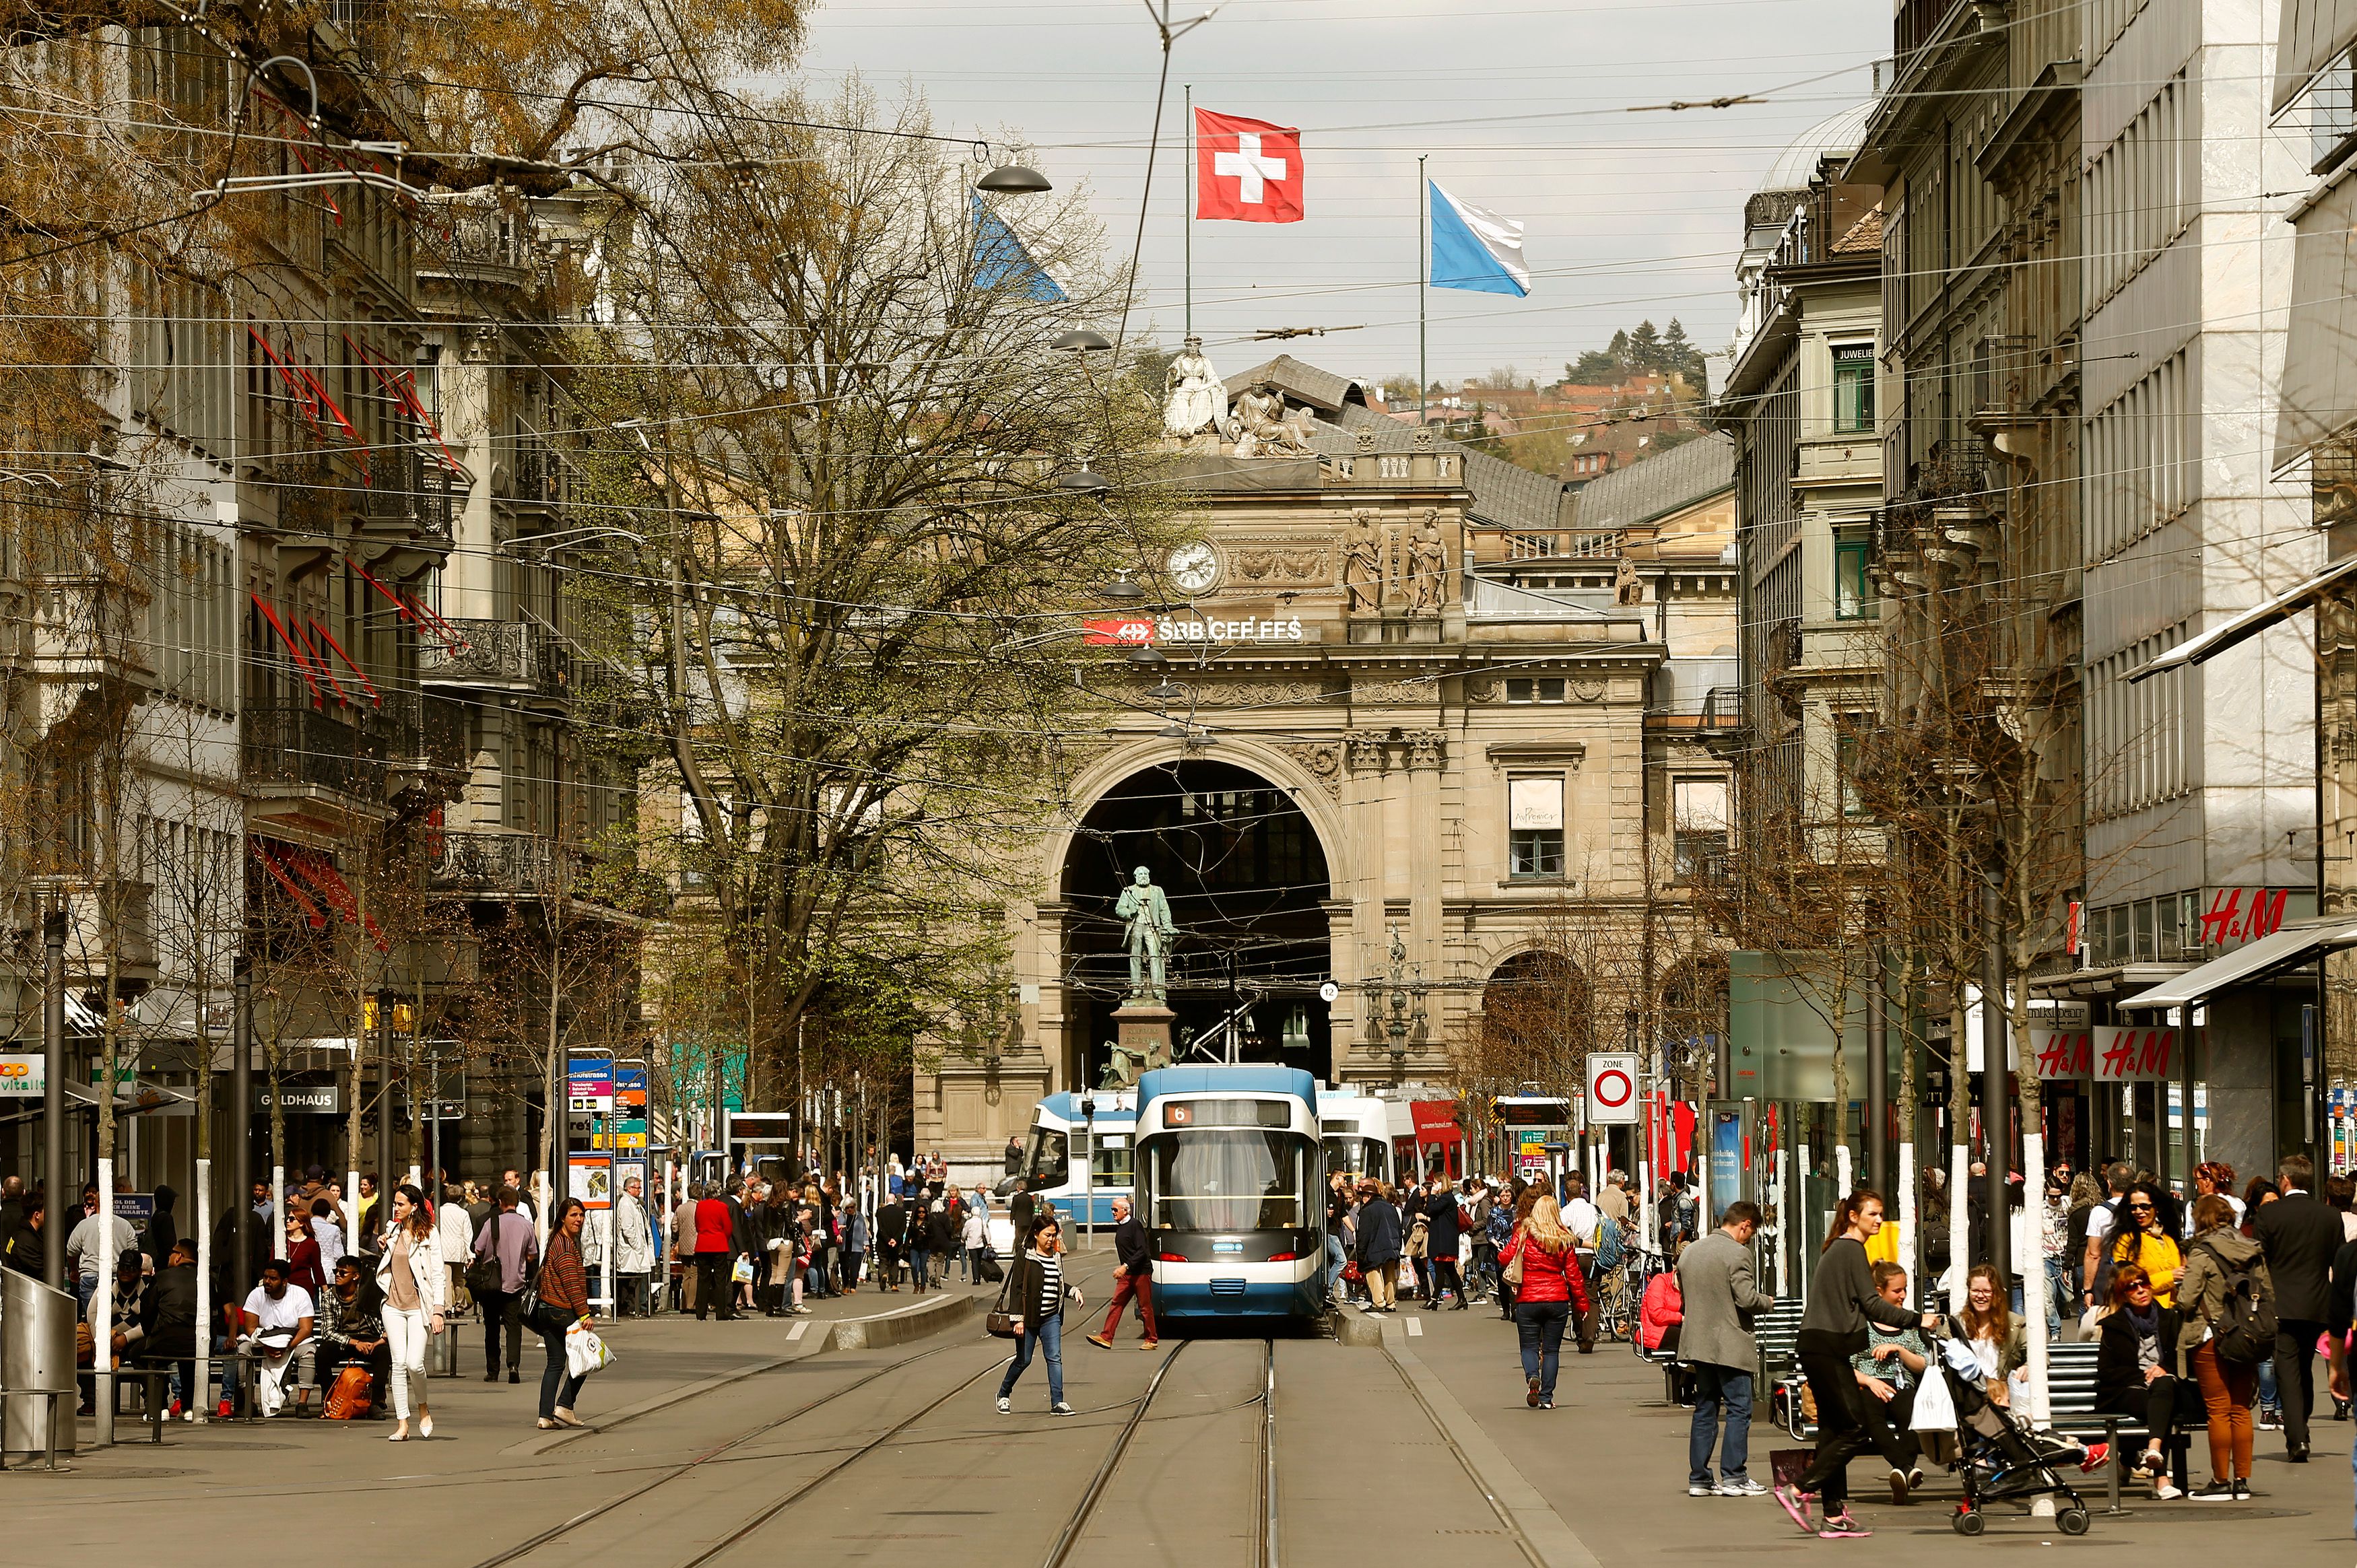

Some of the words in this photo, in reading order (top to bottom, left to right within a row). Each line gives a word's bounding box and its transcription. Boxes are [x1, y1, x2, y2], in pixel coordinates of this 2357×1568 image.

[1159, 621, 1204, 640] SBB
[1209, 621, 1252, 640] CFF
[1260, 621, 1302, 640] FFS
[2199, 888, 2288, 946] H&M
[1325, 988, 1334, 996] 12
[2102, 1030, 2174, 1078] H&M
[1, 1079, 44, 1090] vitalit
[261, 1095, 332, 1105] GLDHAUS
[1174, 1107, 1186, 1121] 6
